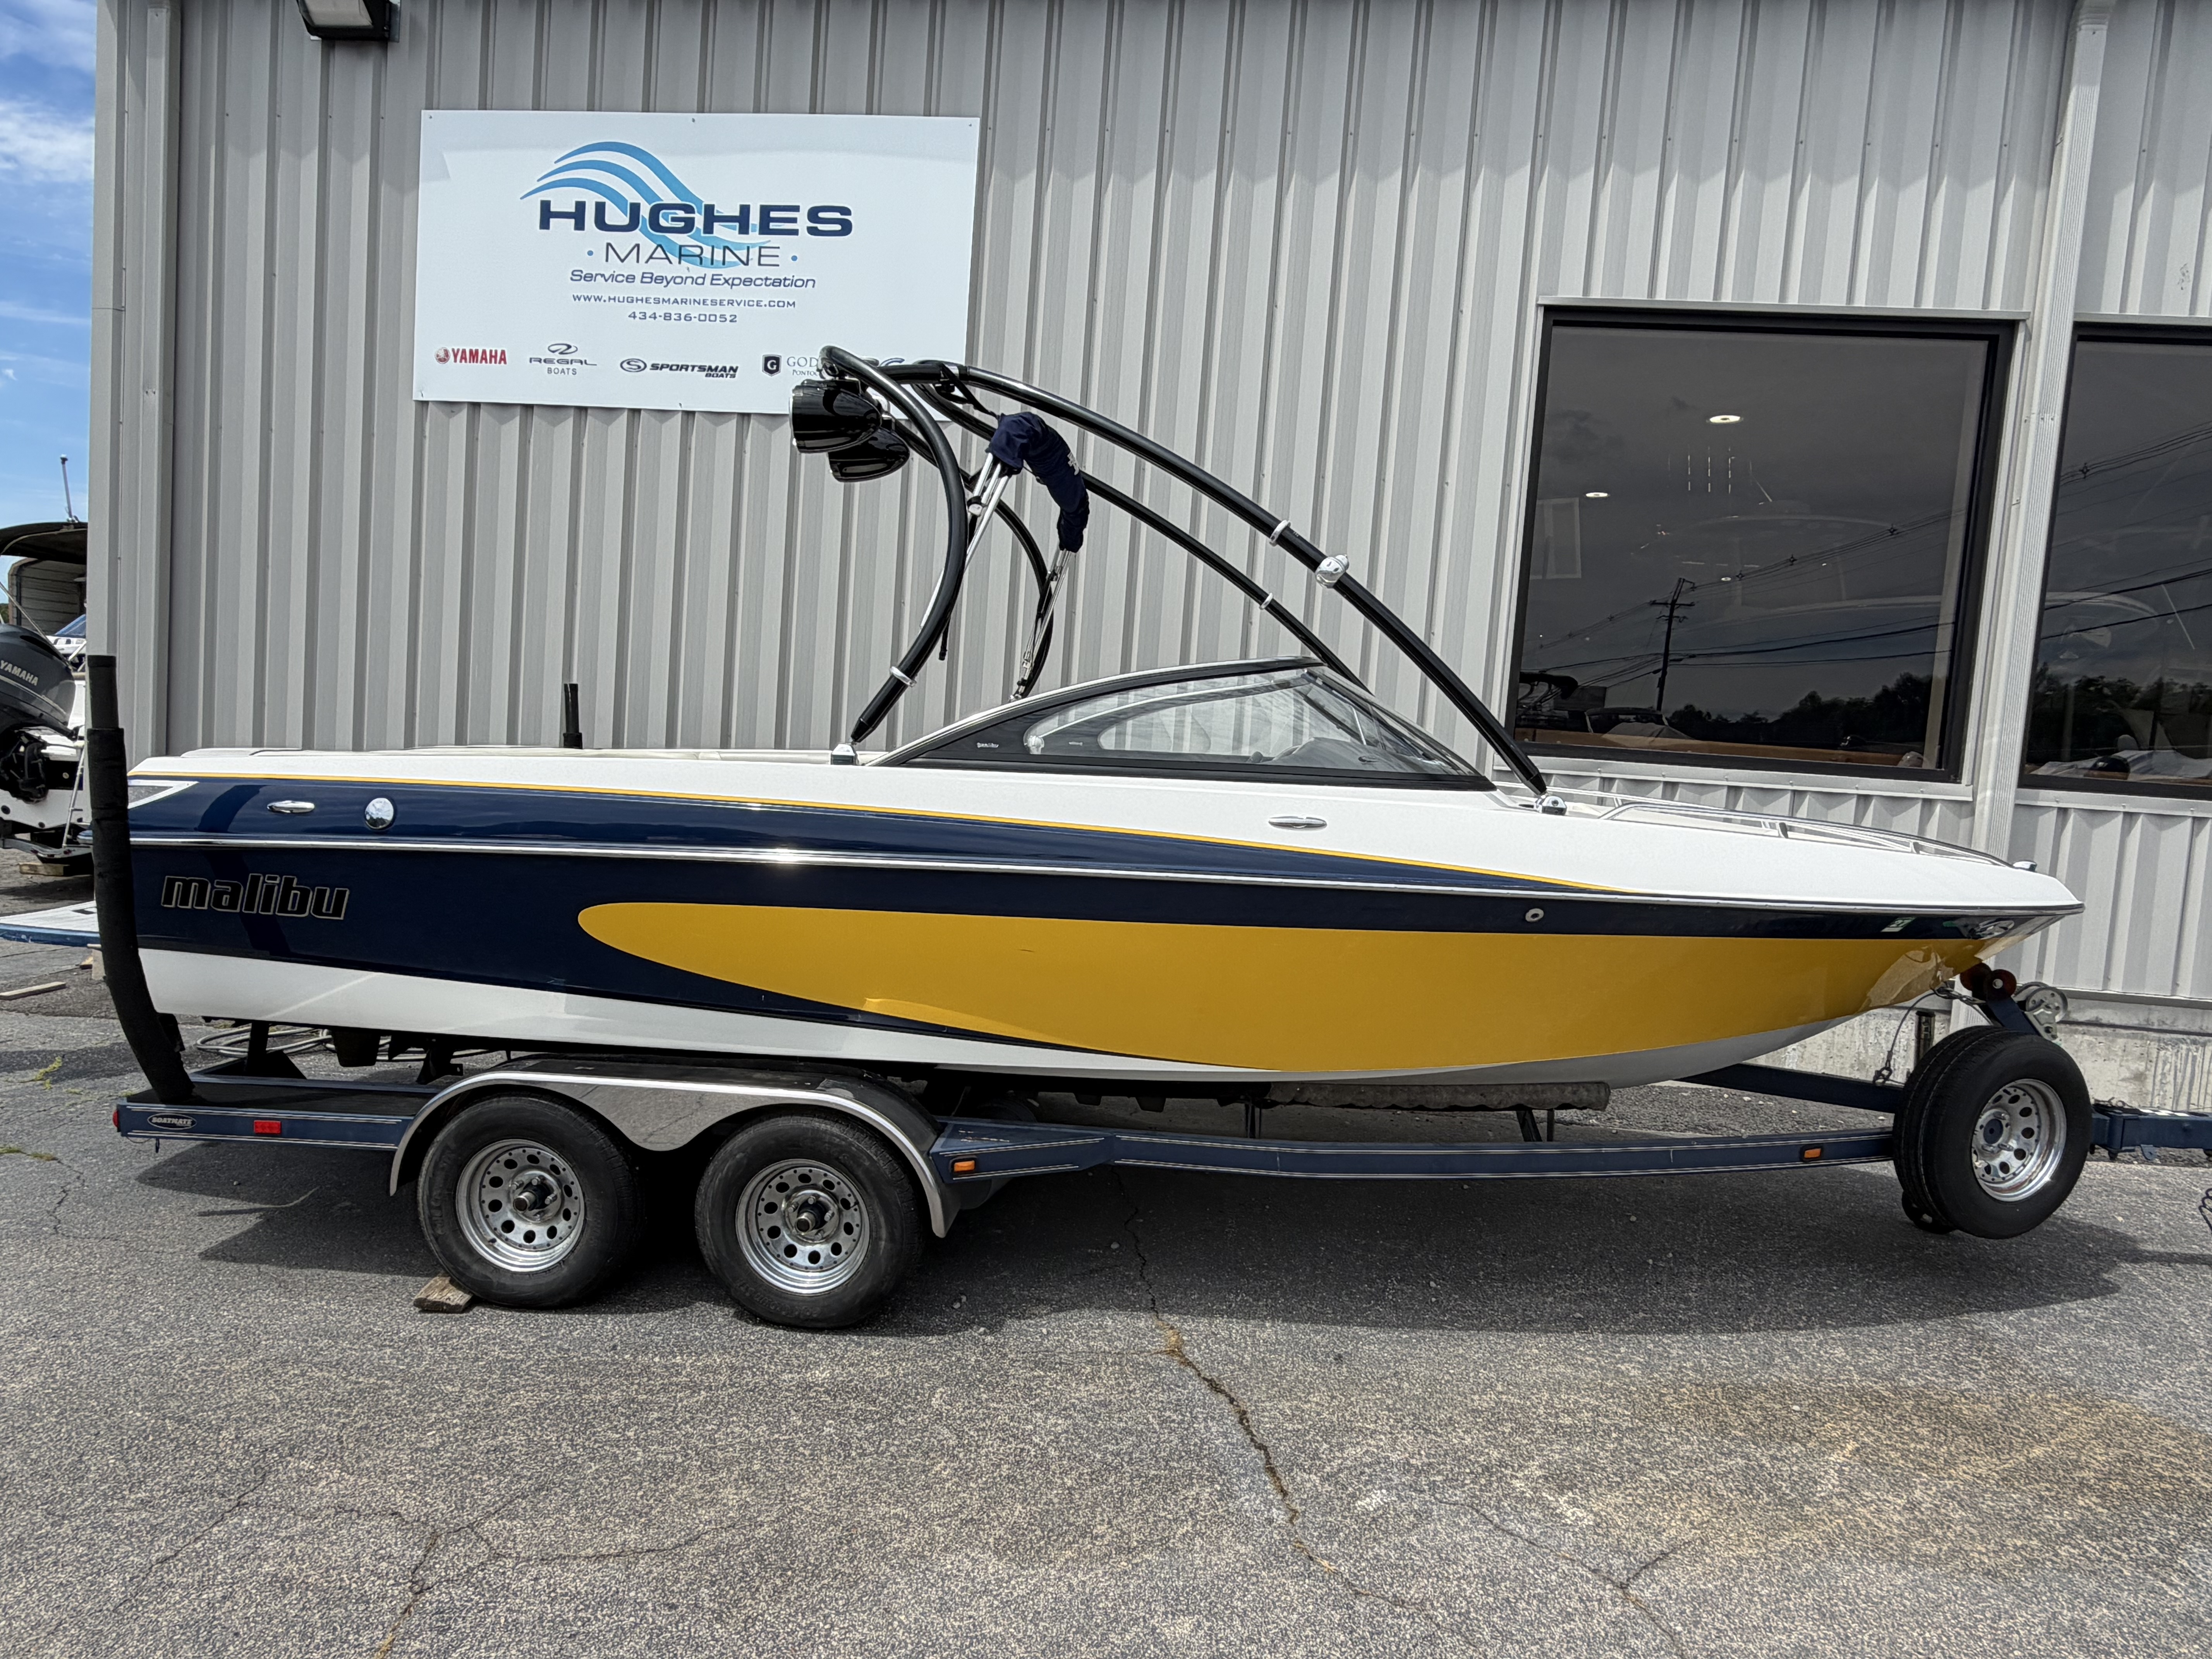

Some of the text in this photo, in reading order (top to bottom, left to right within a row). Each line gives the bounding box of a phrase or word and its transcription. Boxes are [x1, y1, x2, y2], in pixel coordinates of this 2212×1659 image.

[539, 200, 852, 237] HUGHES
[605, 242, 780, 267] MARINE
[570, 270, 816, 289] Service Beyond Expectation
[572, 294, 795, 308] WWW.HUGHESMARINESERVICE.COM
[628, 311, 737, 323] 434-836-0052
[451, 348, 507, 365] YAMAHA
[529, 357, 597, 366] REGAL
[787, 356, 819, 367] GOD
[547, 367, 577, 376] BOATS
[649, 363, 739, 373] SPORTSMAN
[0, 660, 38, 686] YAMAHA
[161, 873, 349, 920] malibu
